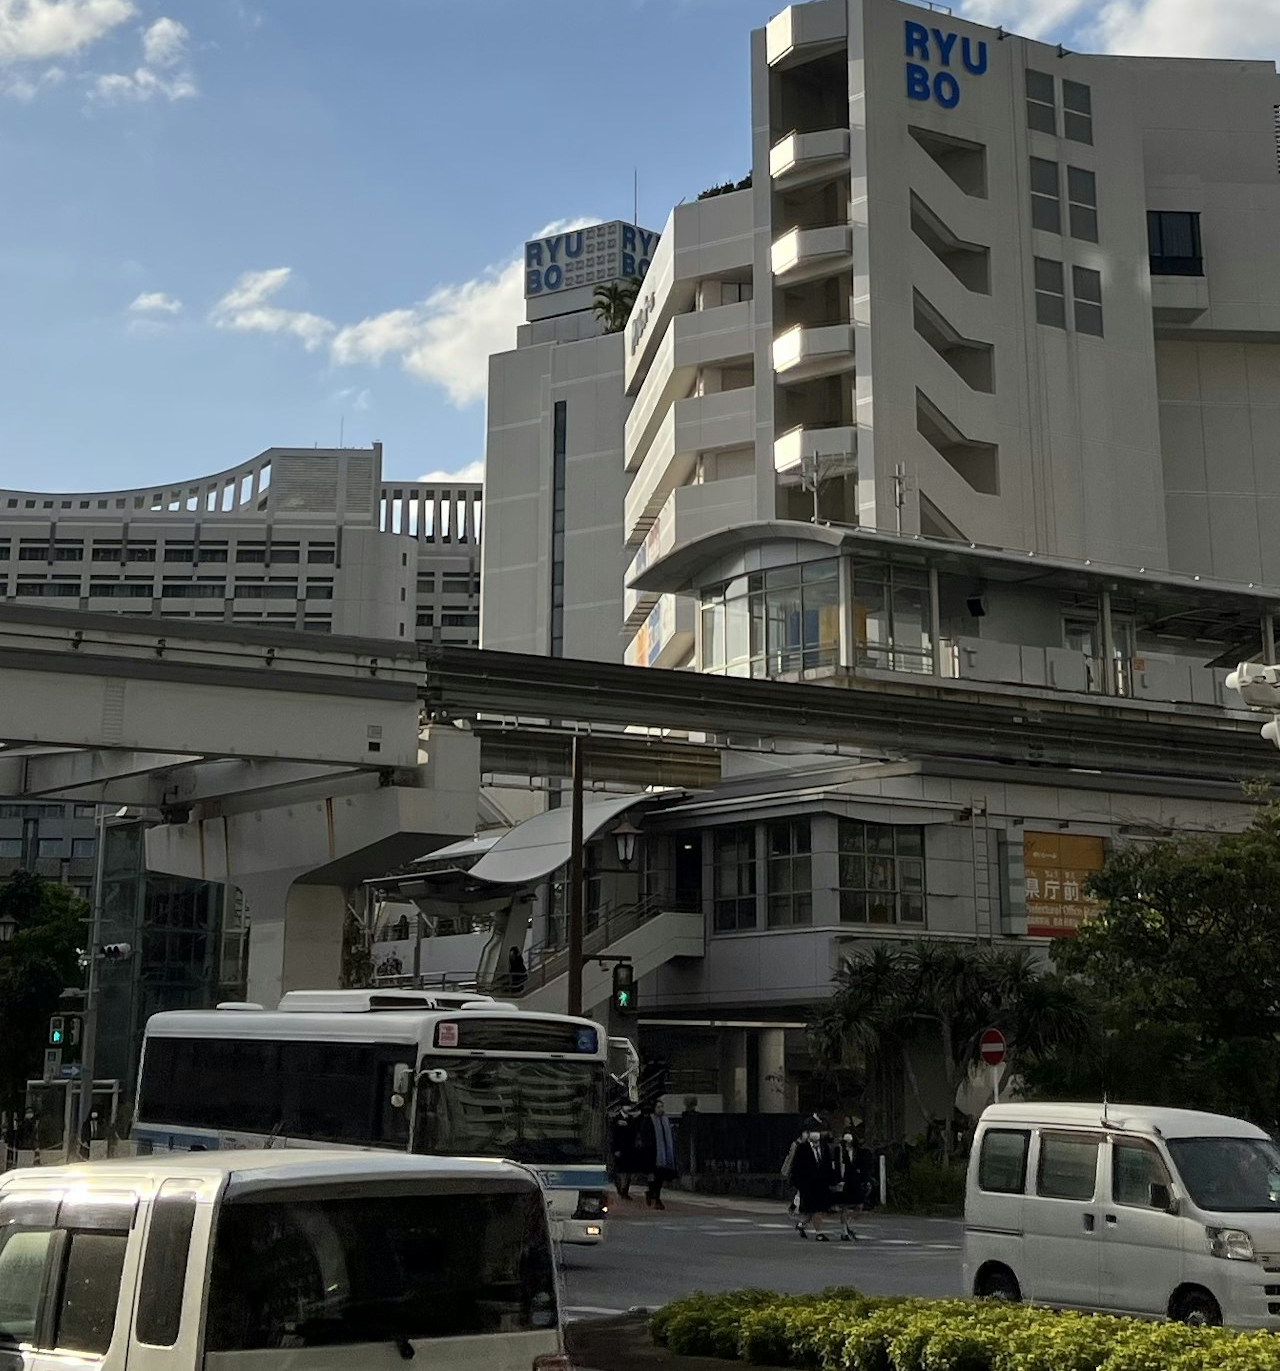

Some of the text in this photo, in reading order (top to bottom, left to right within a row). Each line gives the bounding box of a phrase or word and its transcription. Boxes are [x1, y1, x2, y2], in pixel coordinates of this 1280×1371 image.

[904, 19, 987, 76] RYU
[906, 61, 960, 109] BO
[526, 231, 584, 268] RYU
[622, 225, 660, 256] RY
[526, 264, 562, 295] BO
